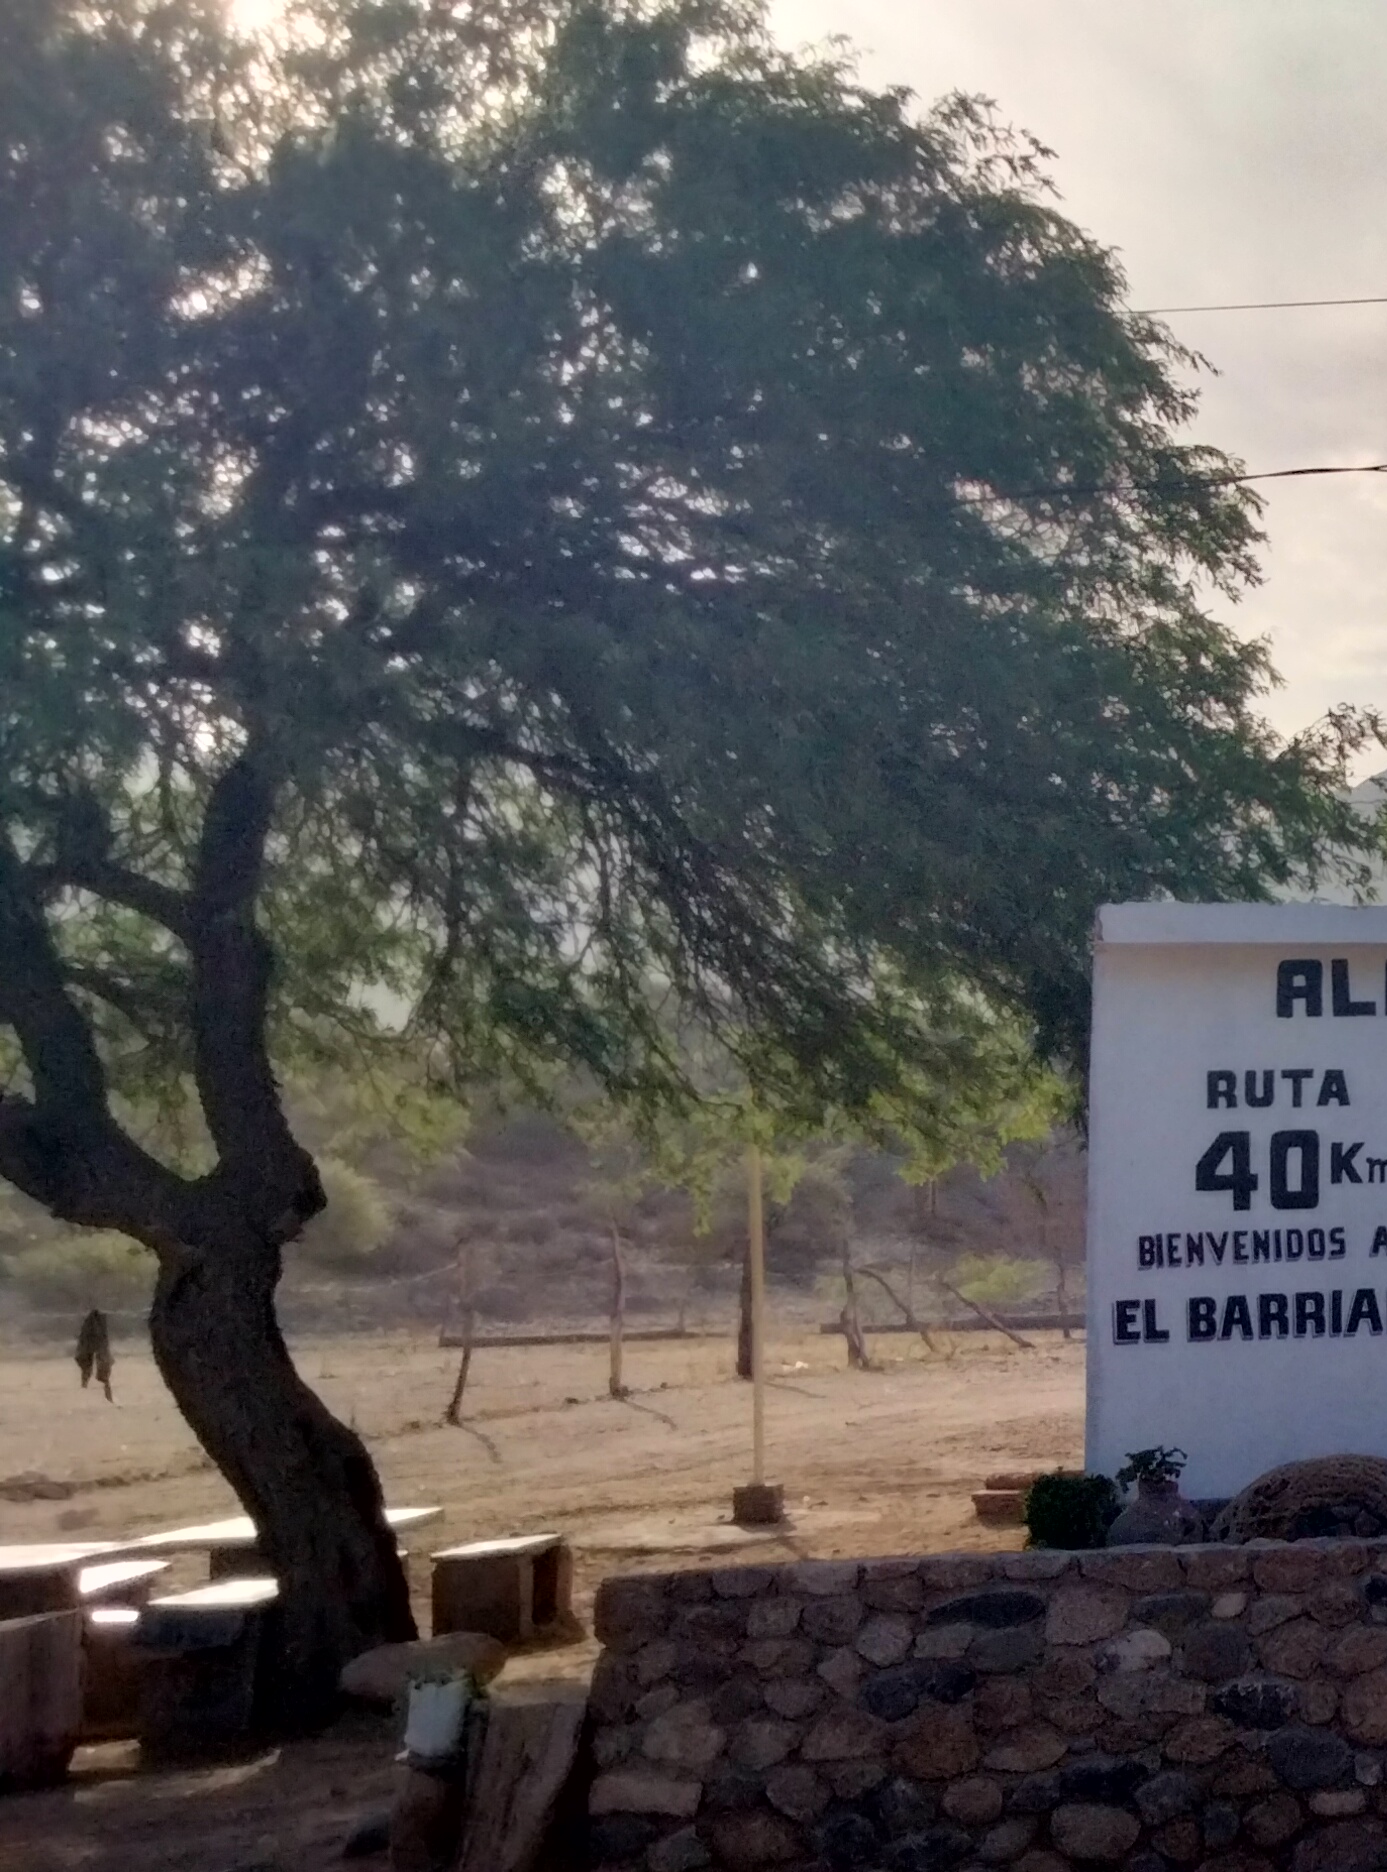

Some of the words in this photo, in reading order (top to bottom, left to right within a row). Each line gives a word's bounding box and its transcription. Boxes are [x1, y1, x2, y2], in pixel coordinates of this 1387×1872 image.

[1207, 1068, 1351, 1109] RUTA
[1196, 1129, 1320, 1211] 40
[1138, 1226, 1347, 1269] BIENVENIDOS
[1113, 1298, 1169, 1344] EL
